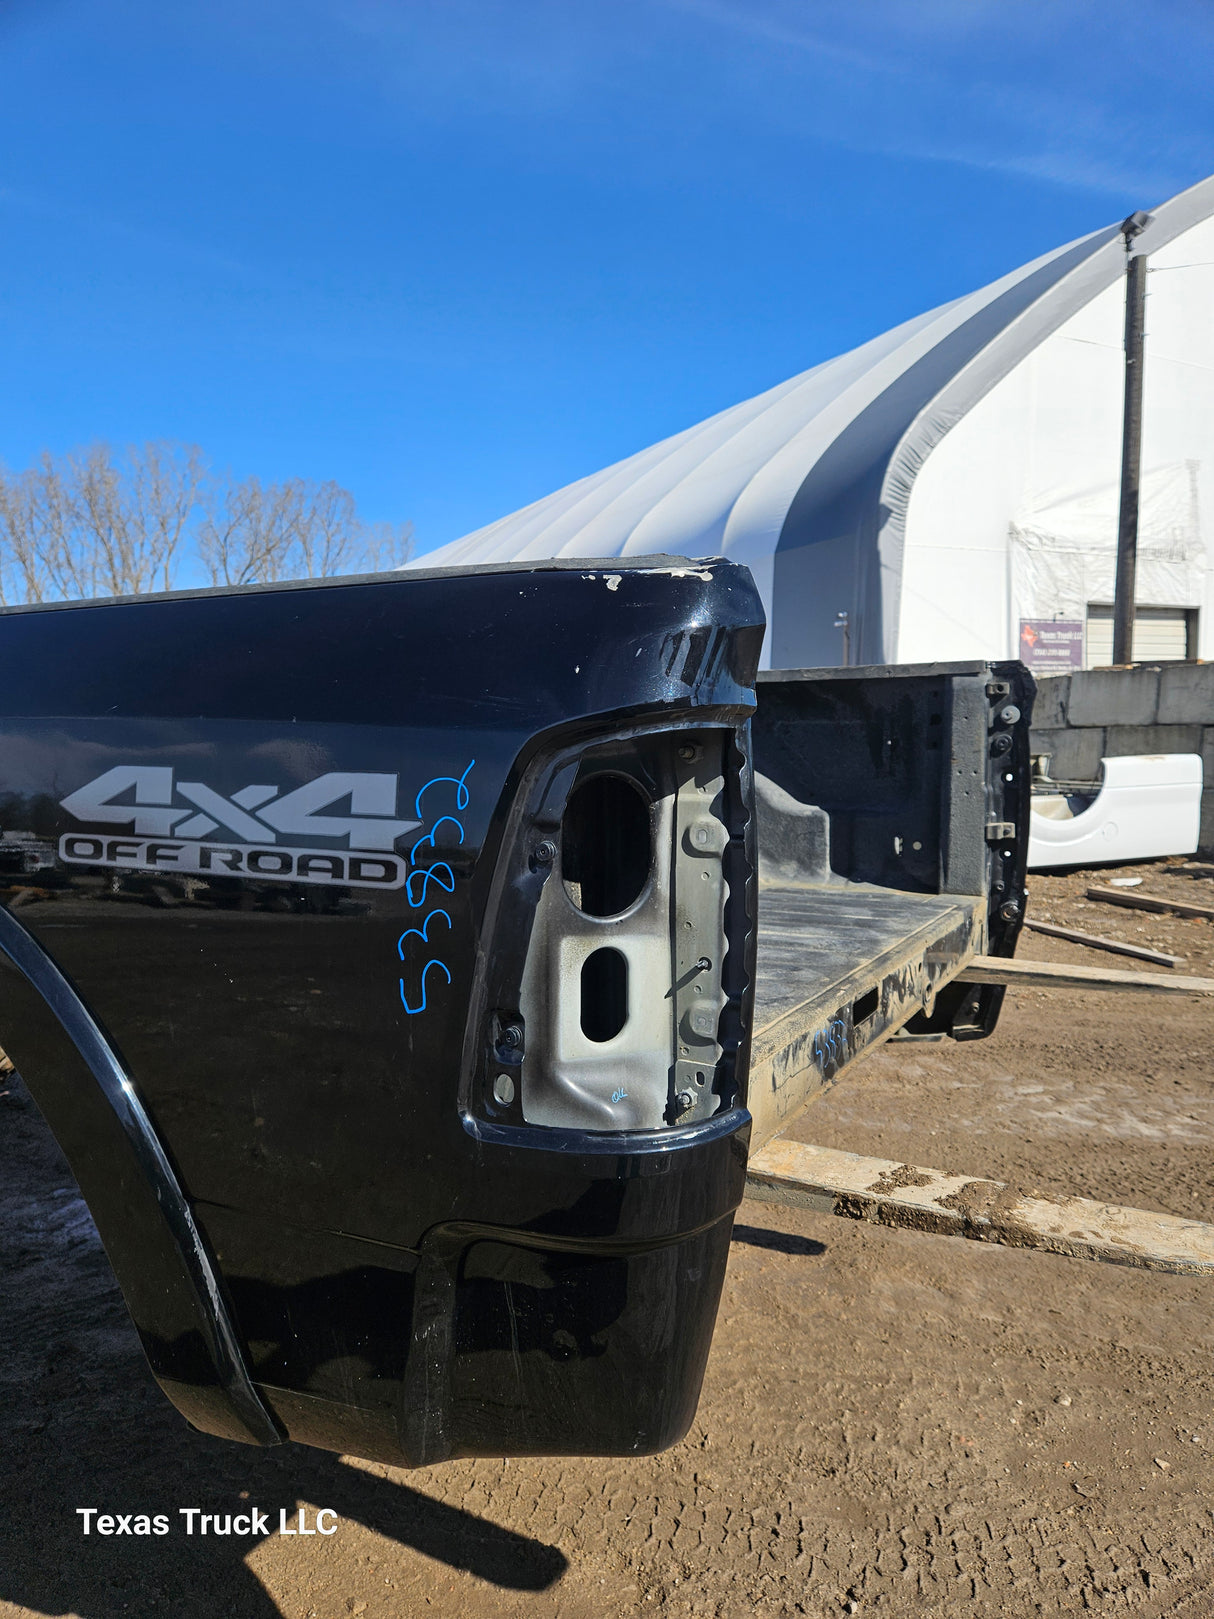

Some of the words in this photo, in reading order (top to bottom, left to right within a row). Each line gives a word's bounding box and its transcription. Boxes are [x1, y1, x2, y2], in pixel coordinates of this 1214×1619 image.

[64, 836, 185, 865] OFF
[201, 845, 398, 884] ROAD
[397, 758, 476, 1014] 53832
